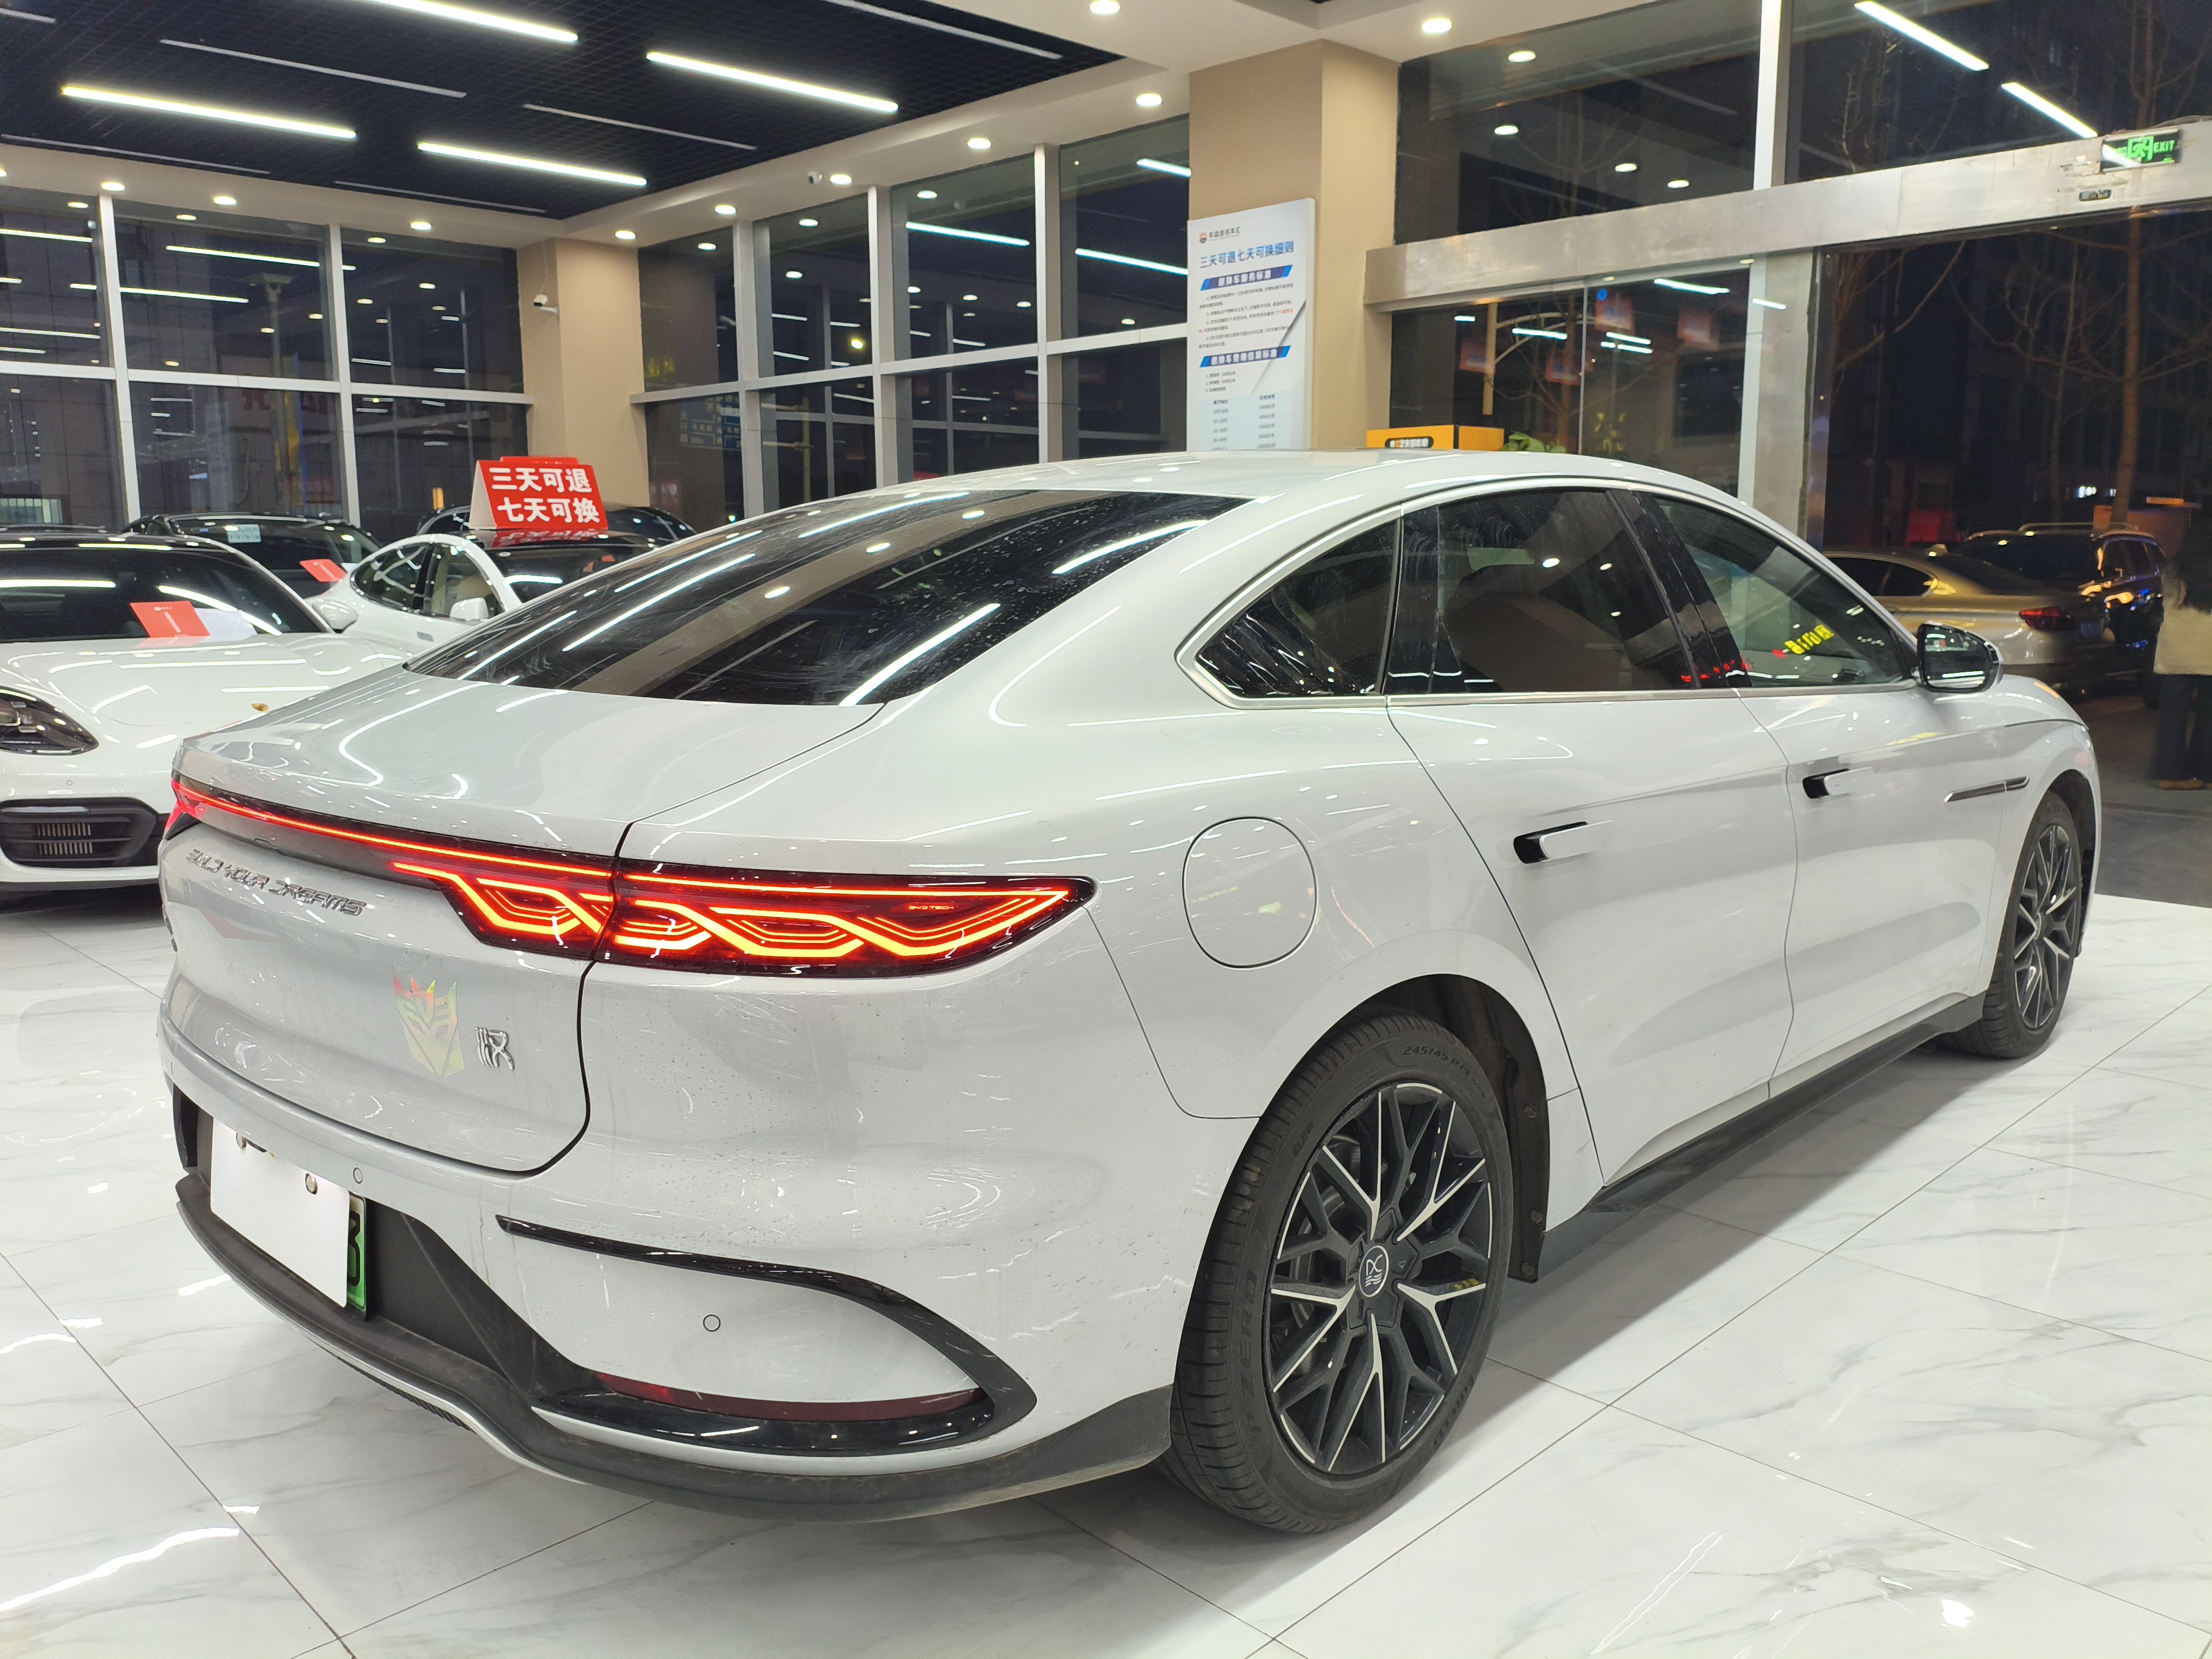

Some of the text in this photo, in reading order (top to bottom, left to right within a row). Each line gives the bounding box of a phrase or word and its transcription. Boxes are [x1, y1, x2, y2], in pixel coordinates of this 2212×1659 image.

[2154, 140, 2175, 153] EXIT
[1200, 240, 1294, 268] 三天可退七天可换细则
[489, 467, 592, 493] 三天可退
[497, 496, 600, 523] 七天可换
[224, 864, 270, 889] YOUR
[268, 879, 367, 916] DREAMS
[1403, 1046, 1448, 1061] 245/45
[1451, 1057, 1471, 1076] R19
